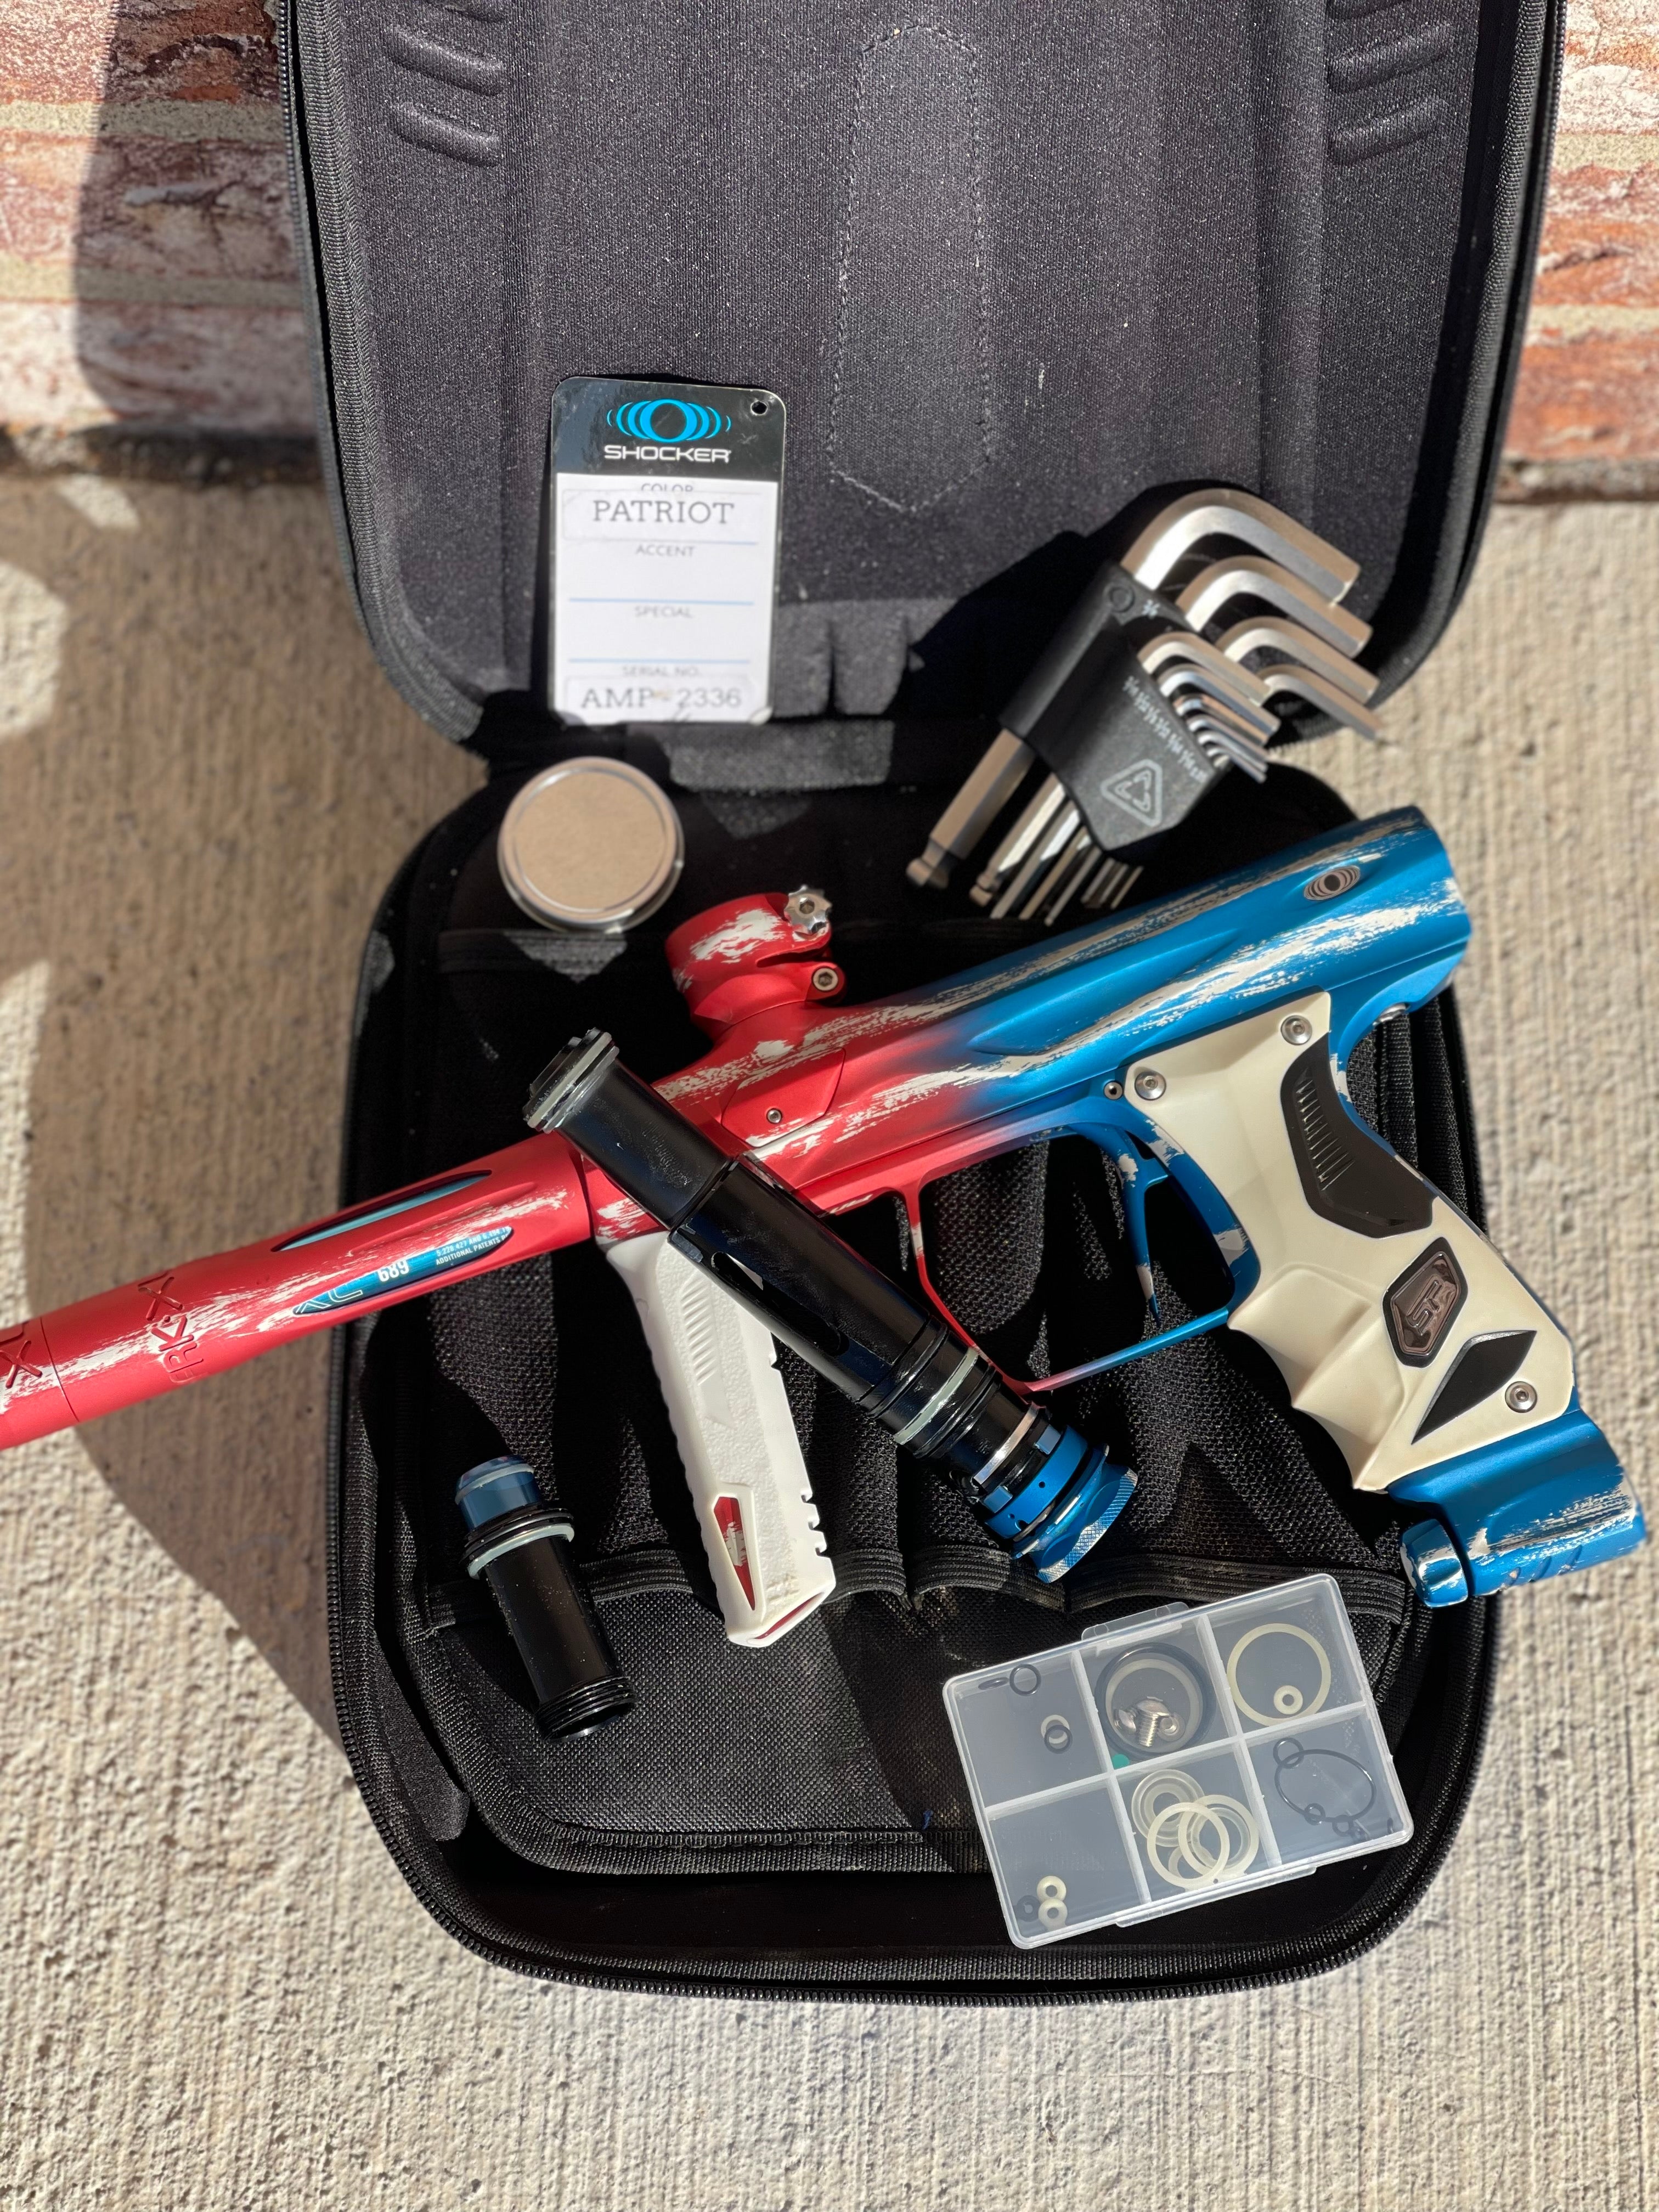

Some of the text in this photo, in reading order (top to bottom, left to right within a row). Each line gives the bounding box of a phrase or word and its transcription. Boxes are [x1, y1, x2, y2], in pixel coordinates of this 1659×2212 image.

[604, 445, 730, 463] SHOCKER
[593, 500, 735, 524] PATRIOT
[635, 544, 695, 556] ACCENT
[635, 605, 693, 618] SPECIAL
[622, 666, 668, 676] SERIAL
[436, 1248, 473, 1265] ADDITIONAL
[473, 1237, 501, 1251] PATENTS
[377, 1259, 410, 1283] 689
